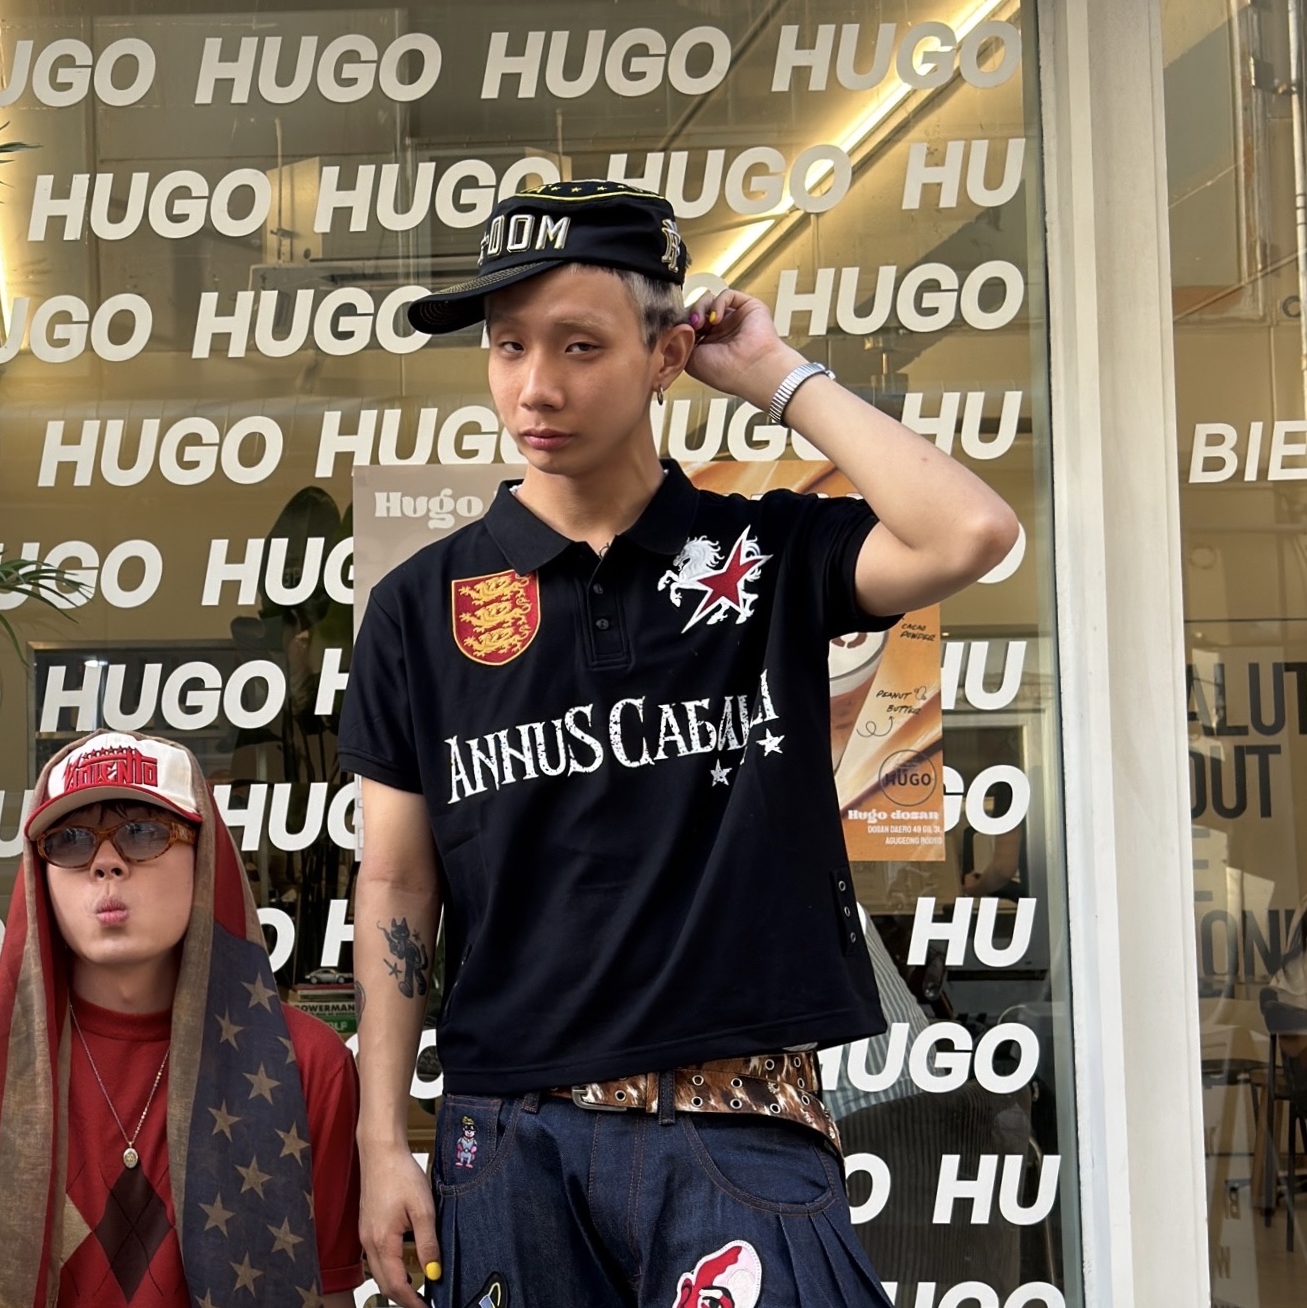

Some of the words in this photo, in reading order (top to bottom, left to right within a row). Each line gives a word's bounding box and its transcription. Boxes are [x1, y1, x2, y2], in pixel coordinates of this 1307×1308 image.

[194, 34, 442, 104] HUGO
[482, 26, 731, 100] HUGO
[771, 20, 1022, 92] HUGO
[27, 169, 272, 242] HUGO
[903, 137, 1026, 210] HU
[192, 286, 433, 358] HUGO
[776, 260, 1024, 337] HUGO
[37, 415, 284, 488] HUGO
[315, 405, 529, 478] HUG
[374, 489, 483, 529] Hugo
[201, 537, 354, 607] HUG
[40, 659, 287, 732] HUGO
[876, 690, 912, 699] PEANUT
[886, 705, 922, 715] BUTTER
[444, 703, 604, 805] ANNUS
[885, 772, 932, 787] HUGO
[214, 782, 360, 852] HUG
[848, 809, 888, 824] Hugo
[891, 810, 939, 820] dosan
[906, 897, 1037, 967] HU
[933, 1154, 1060, 1225] HU
